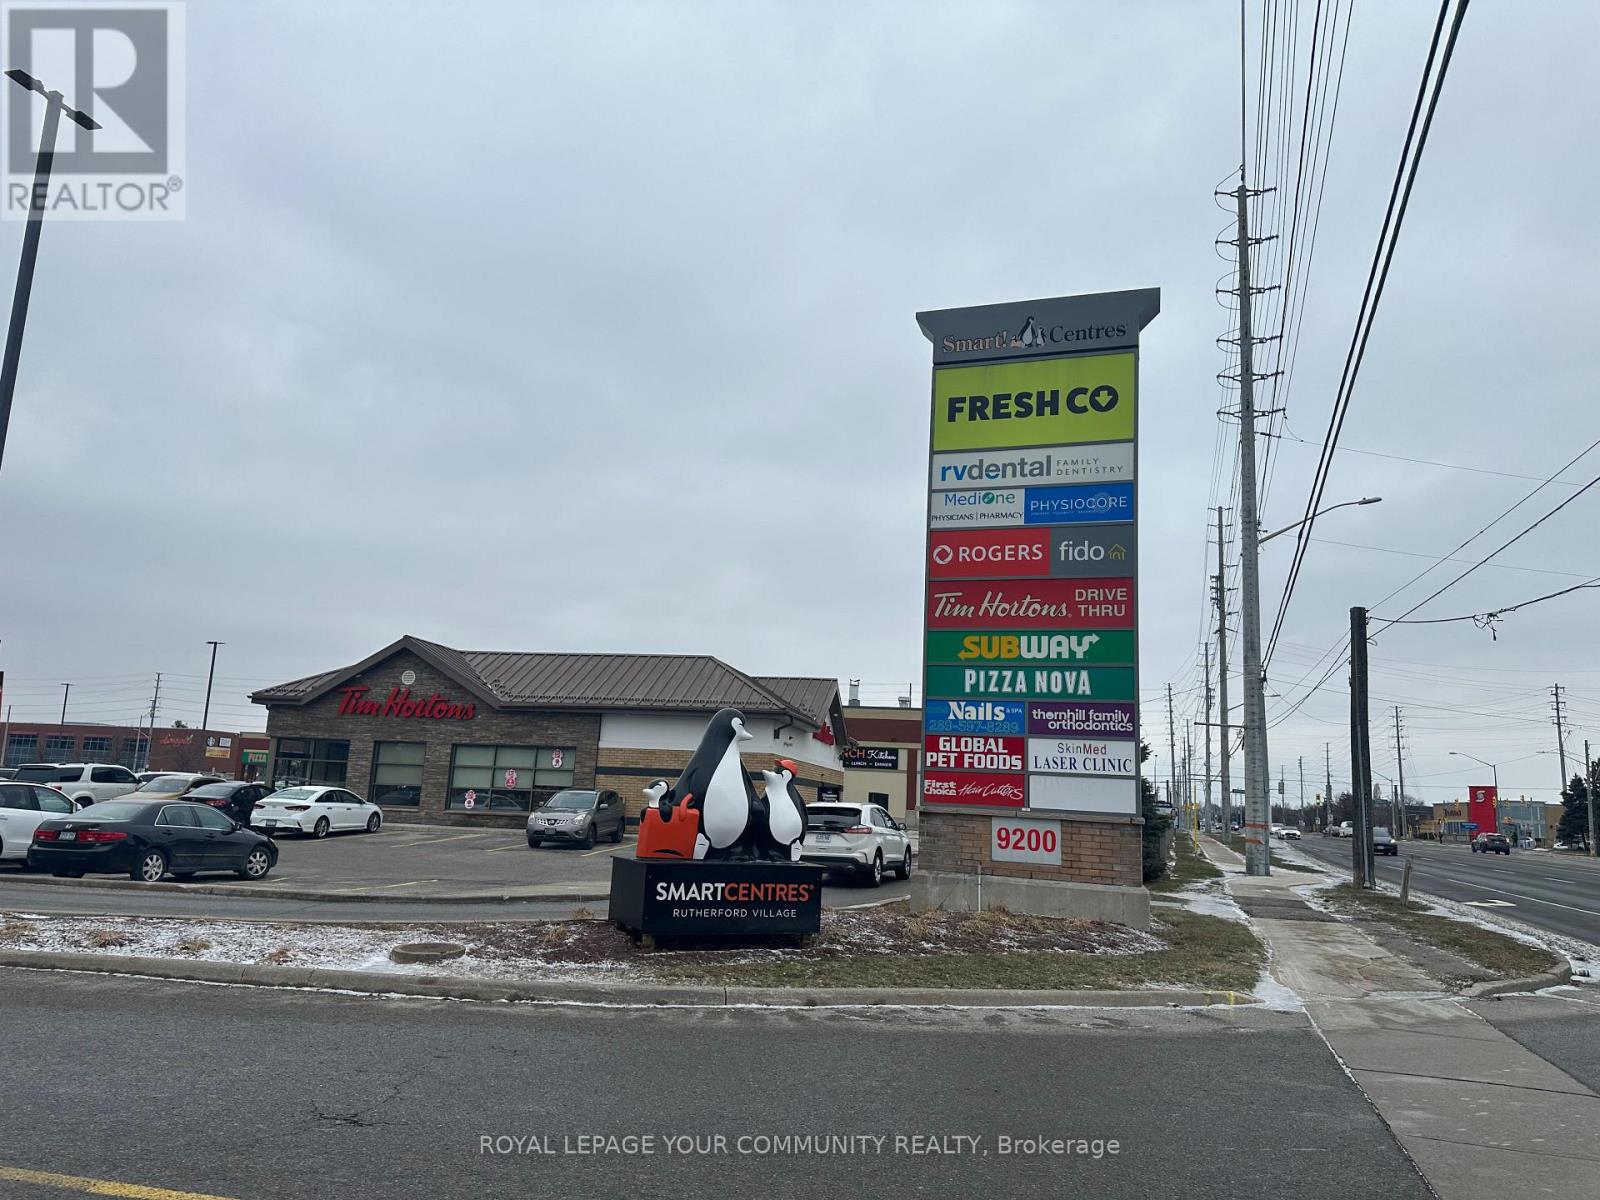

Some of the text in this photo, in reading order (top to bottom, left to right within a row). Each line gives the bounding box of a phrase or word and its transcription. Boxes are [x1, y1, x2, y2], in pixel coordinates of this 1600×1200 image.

[1050, 323, 1127, 343] Centres
[940, 455, 1052, 481] rvdental
[1056, 457, 1100, 466] FAMILY
[1056, 466, 1124, 476] DENTISTRY
[1030, 496, 1128, 512] PHYSIOCORE
[931, 512, 974, 521] PHYSICIANS
[979, 511, 1023, 520] PHARMACY
[958, 544, 1043, 562] ROGERS
[1058, 541, 1105, 561] fido
[1074, 588, 1128, 601] DRIVE
[934, 591, 1068, 618] Tim Hortons
[1077, 604, 1126, 617] THRU
[957, 632, 1100, 661] SUBWAY
[964, 668, 1092, 696] PIZZA NOVA
[337, 685, 476, 720] Tim Hortons
[947, 701, 1006, 721] Nails
[1087, 709, 1130, 723] family
[1047, 719, 1133, 732] orthodontics
[938, 736, 1008, 753] GLOBAL
[1057, 742, 1107, 755] SkinMed
[926, 753, 1022, 770] PET FOODS
[1034, 756, 1132, 773] LASER CLINIC
[924, 779, 957, 788] First
[924, 787, 957, 796] Choice
[996, 827, 1057, 853] 9200
[672, 908, 797, 918] RUTHERFORD VILLAGE
